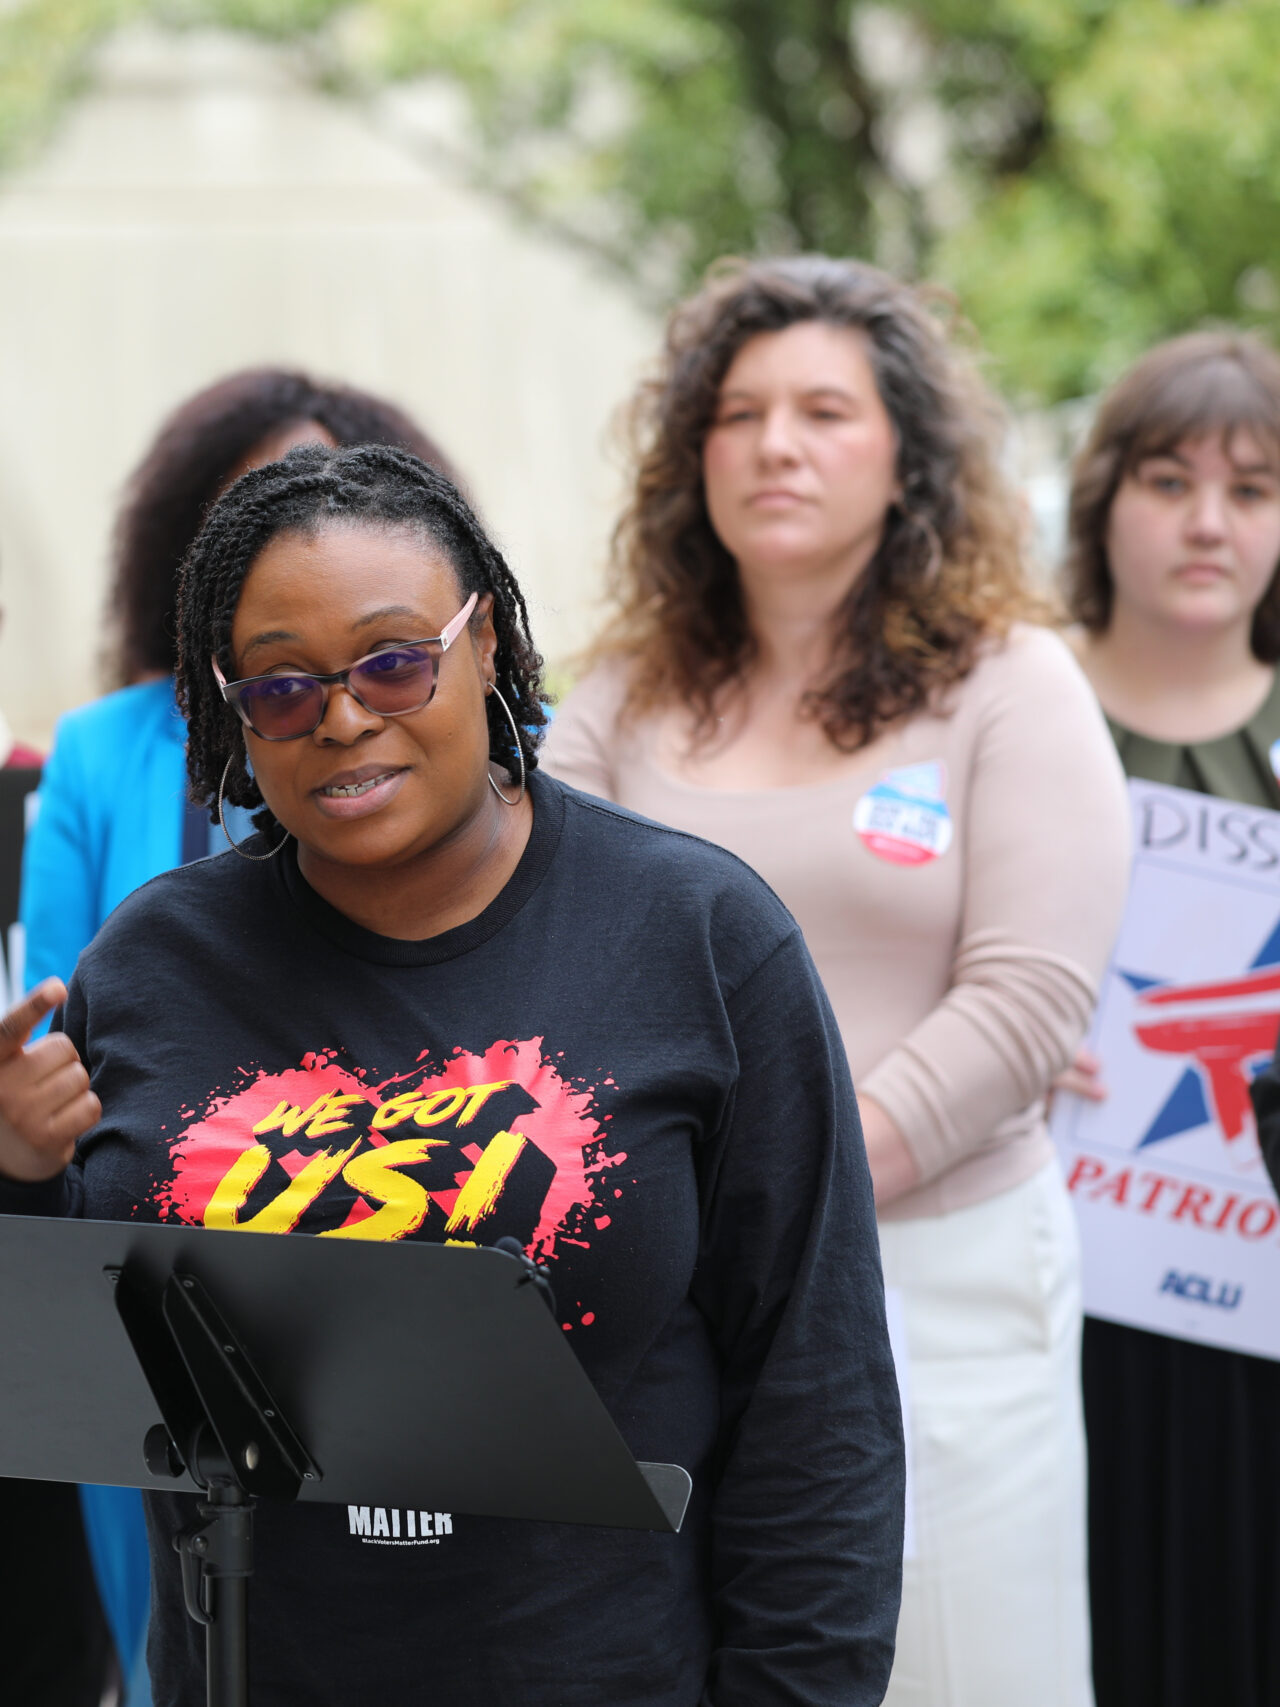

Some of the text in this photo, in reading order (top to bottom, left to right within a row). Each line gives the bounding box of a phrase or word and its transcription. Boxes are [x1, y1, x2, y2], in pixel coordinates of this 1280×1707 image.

[253, 1079, 517, 1139] WE GOT
[203, 1130, 527, 1248] US!
[1066, 1154, 1280, 1248] PATRIO
[1160, 1269, 1243, 1311] ACLU
[347, 1504, 453, 1538] MATTER
